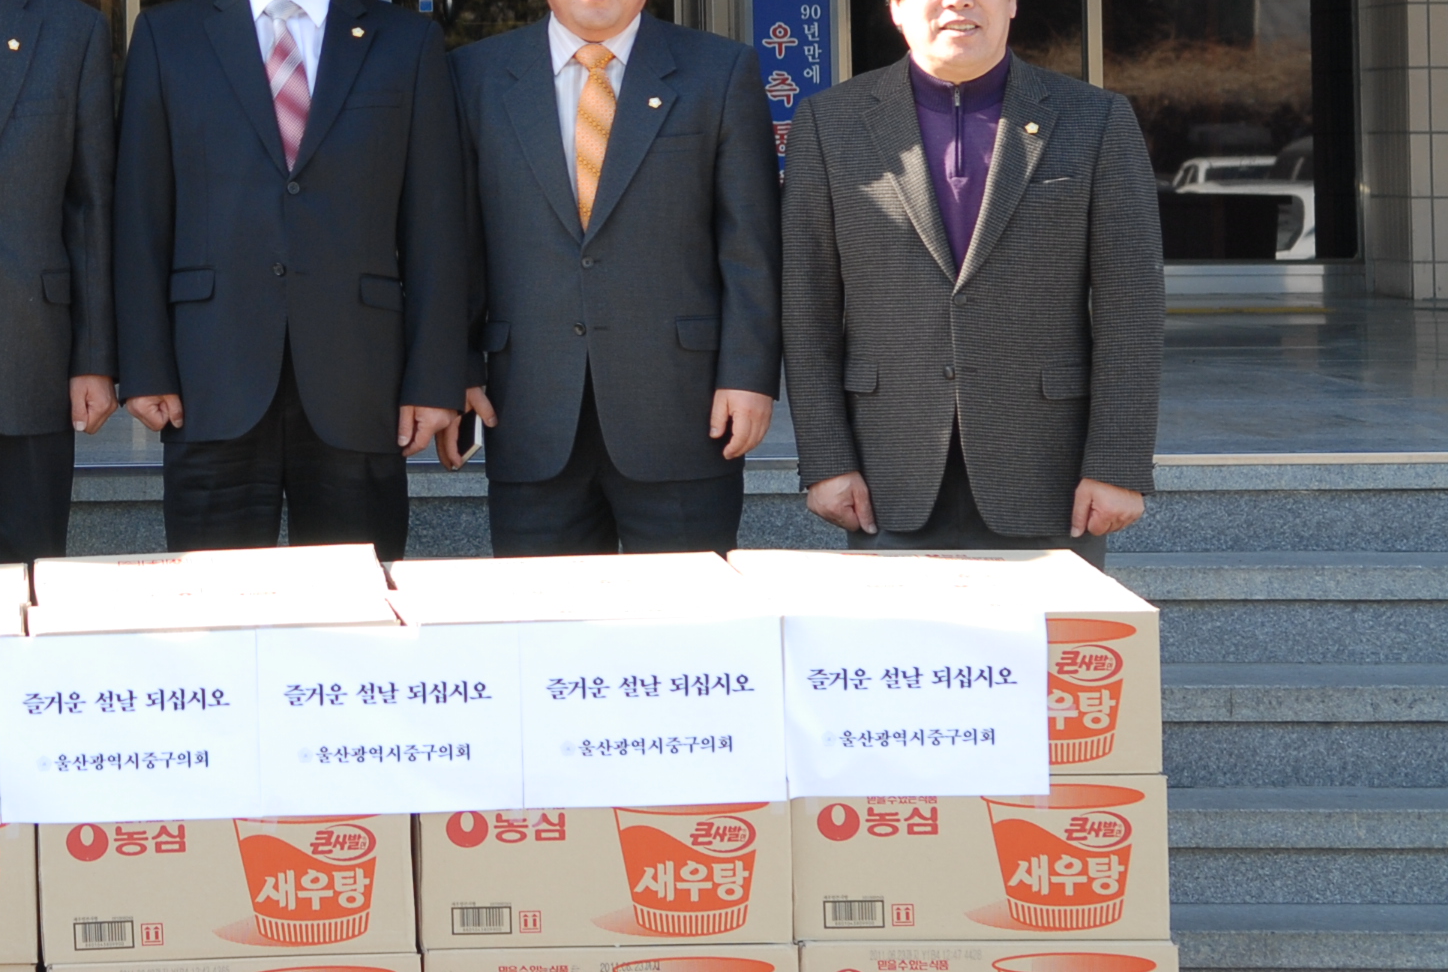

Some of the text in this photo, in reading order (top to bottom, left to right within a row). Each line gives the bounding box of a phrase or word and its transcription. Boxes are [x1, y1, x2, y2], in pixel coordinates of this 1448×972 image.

[800, 4, 822, 85] 90년만에
[286, 679, 493, 707] 즐거운 설날 되십시오
[546, 671, 755, 701] 즐거운 설날 되십시오
[806, 664, 1018, 692] 즐거운 설날 되십시오
[24, 687, 230, 716] 즐거운 설날 되십시오
[1047, 688, 1118, 731] 우탕
[579, 734, 734, 757] 울산광역시중구의회
[840, 727, 996, 748] 울산광역시중구의회
[55, 749, 210, 773] 울산광역시중구의회
[316, 742, 471, 764] 울산광역시중구의회
[494, 812, 567, 844] 농심
[865, 806, 939, 837] 농심
[114, 824, 187, 856] 농심
[255, 868, 371, 912] 새우탕
[633, 860, 750, 903] 새우탕
[1007, 853, 1126, 897] 새우탕
